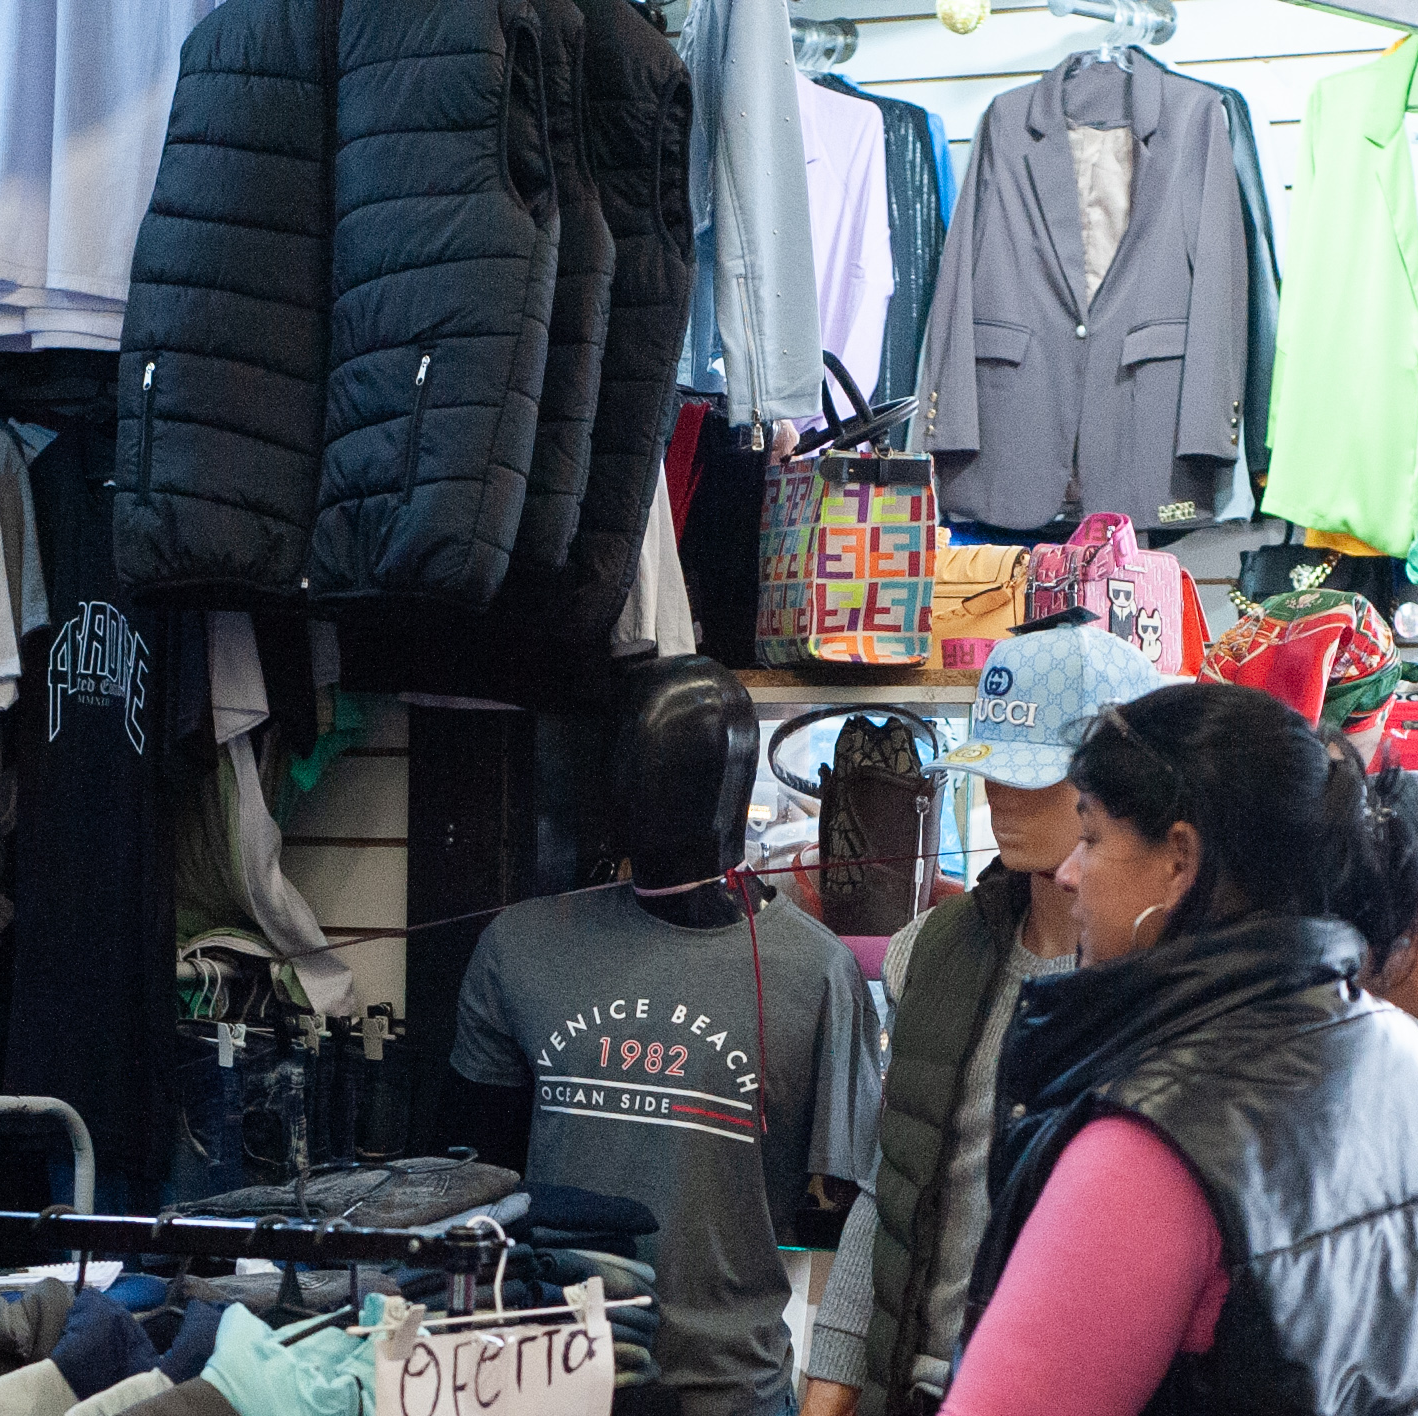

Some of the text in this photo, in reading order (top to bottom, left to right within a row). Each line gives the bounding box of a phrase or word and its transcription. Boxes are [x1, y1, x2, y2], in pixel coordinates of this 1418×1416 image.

[974, 698, 1038, 727] UCCI
[537, 999, 759, 1093] VENICE BEACH
[599, 1037, 688, 1077] 1982
[541, 1086, 670, 1114] OCEAN SIDE
